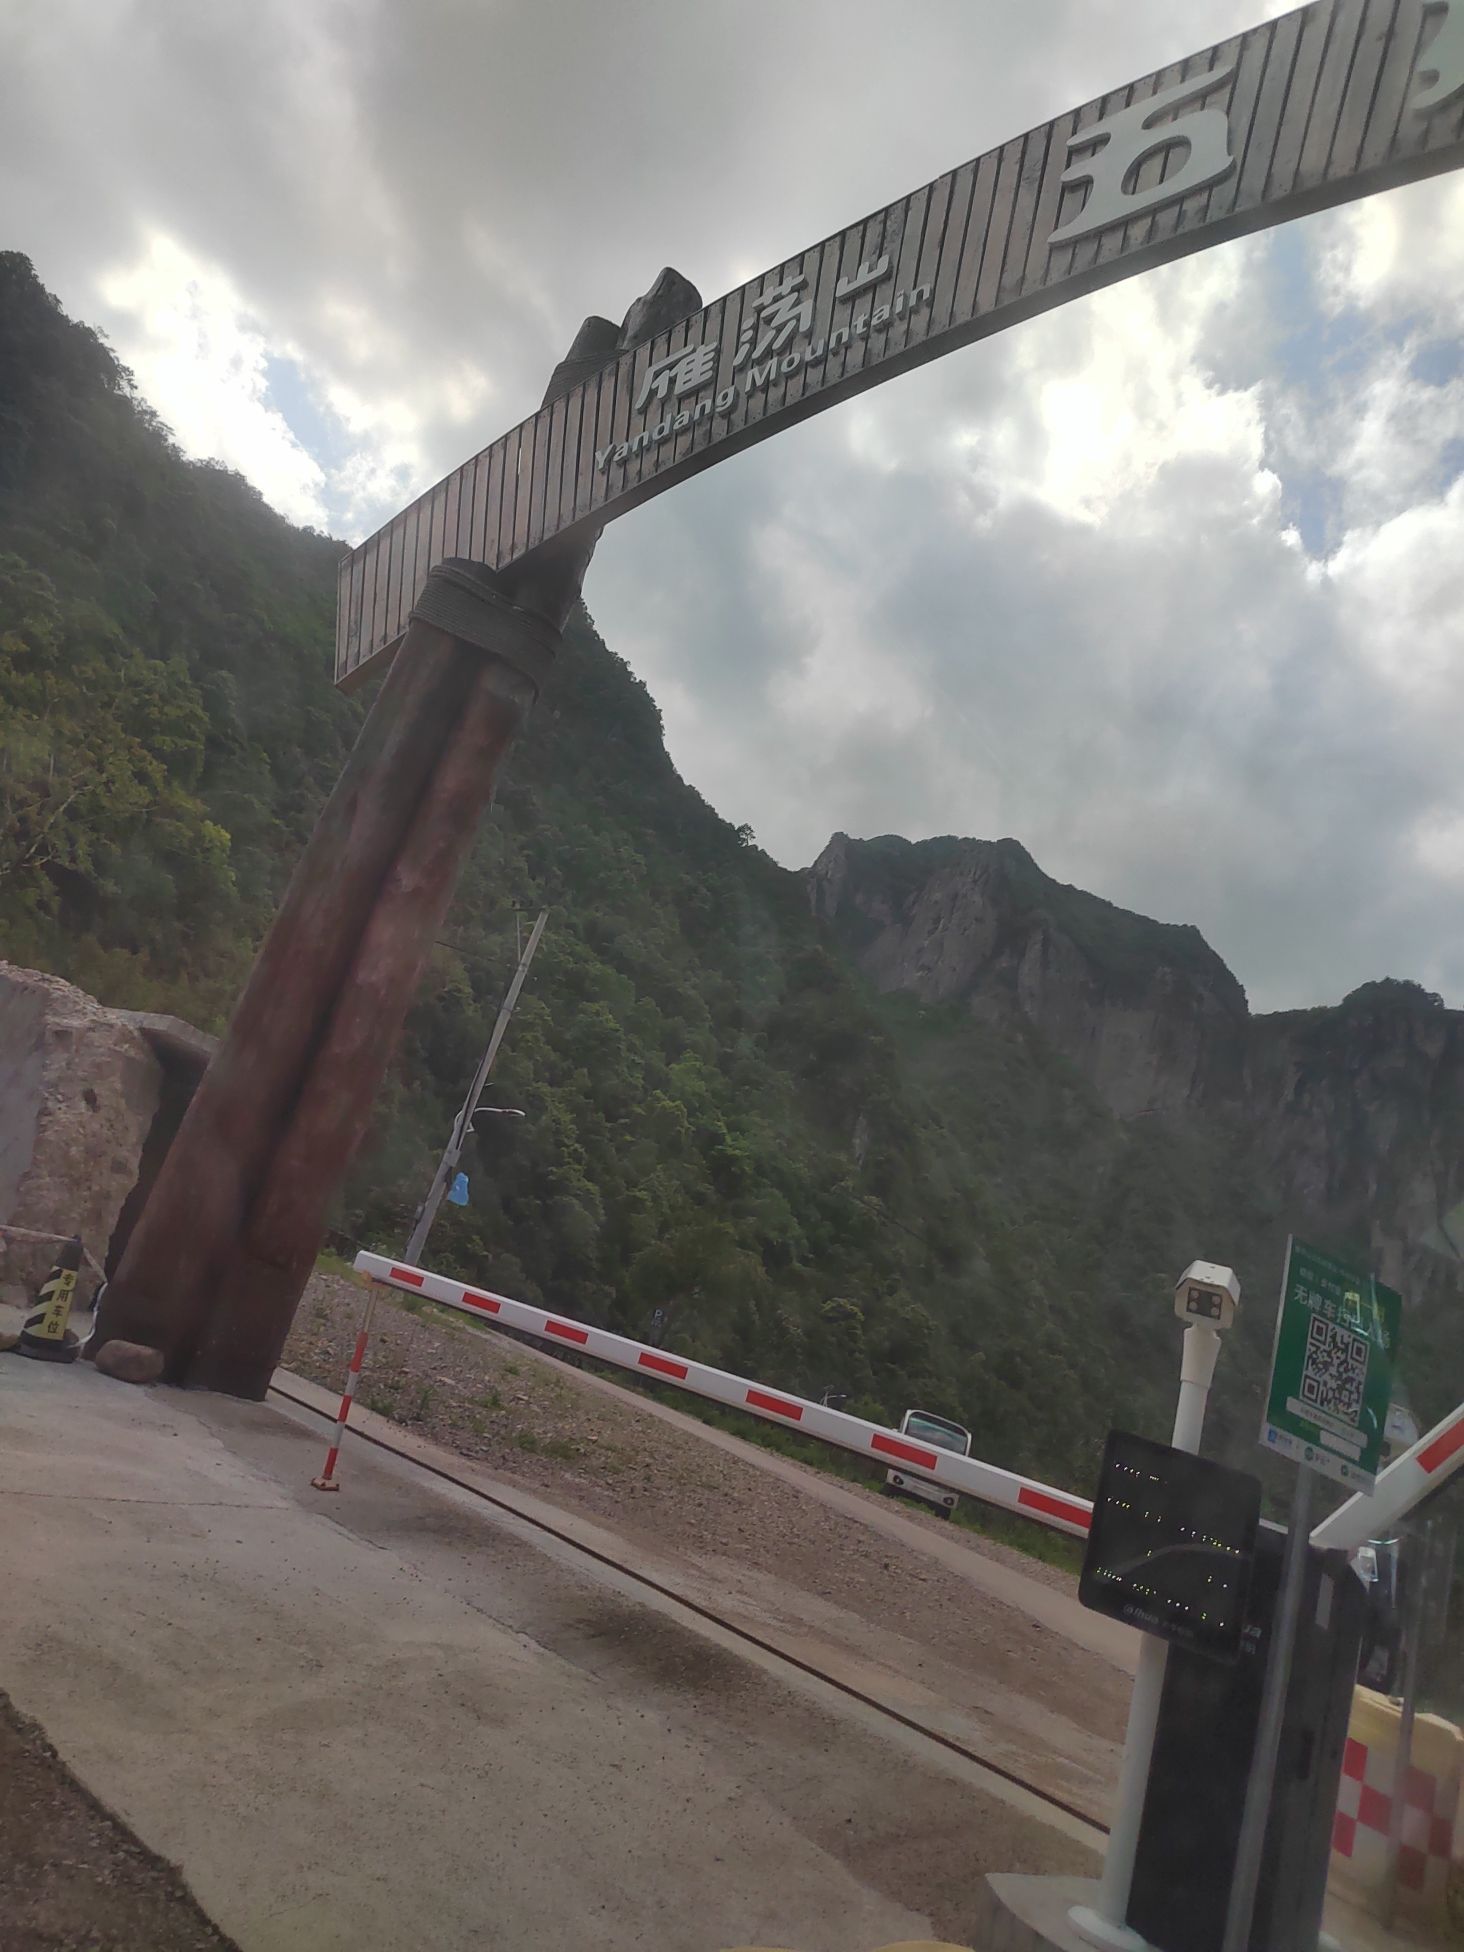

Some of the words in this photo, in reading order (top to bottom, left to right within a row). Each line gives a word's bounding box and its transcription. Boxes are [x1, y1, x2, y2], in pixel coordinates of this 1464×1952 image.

[594, 384, 738, 474] Yandang
[744, 282, 931, 396] Mountain
[634, 254, 891, 410] 雁荡山
[47, 1273, 74, 1334] 专用车位
[654, 1309, 663, 1319] P
